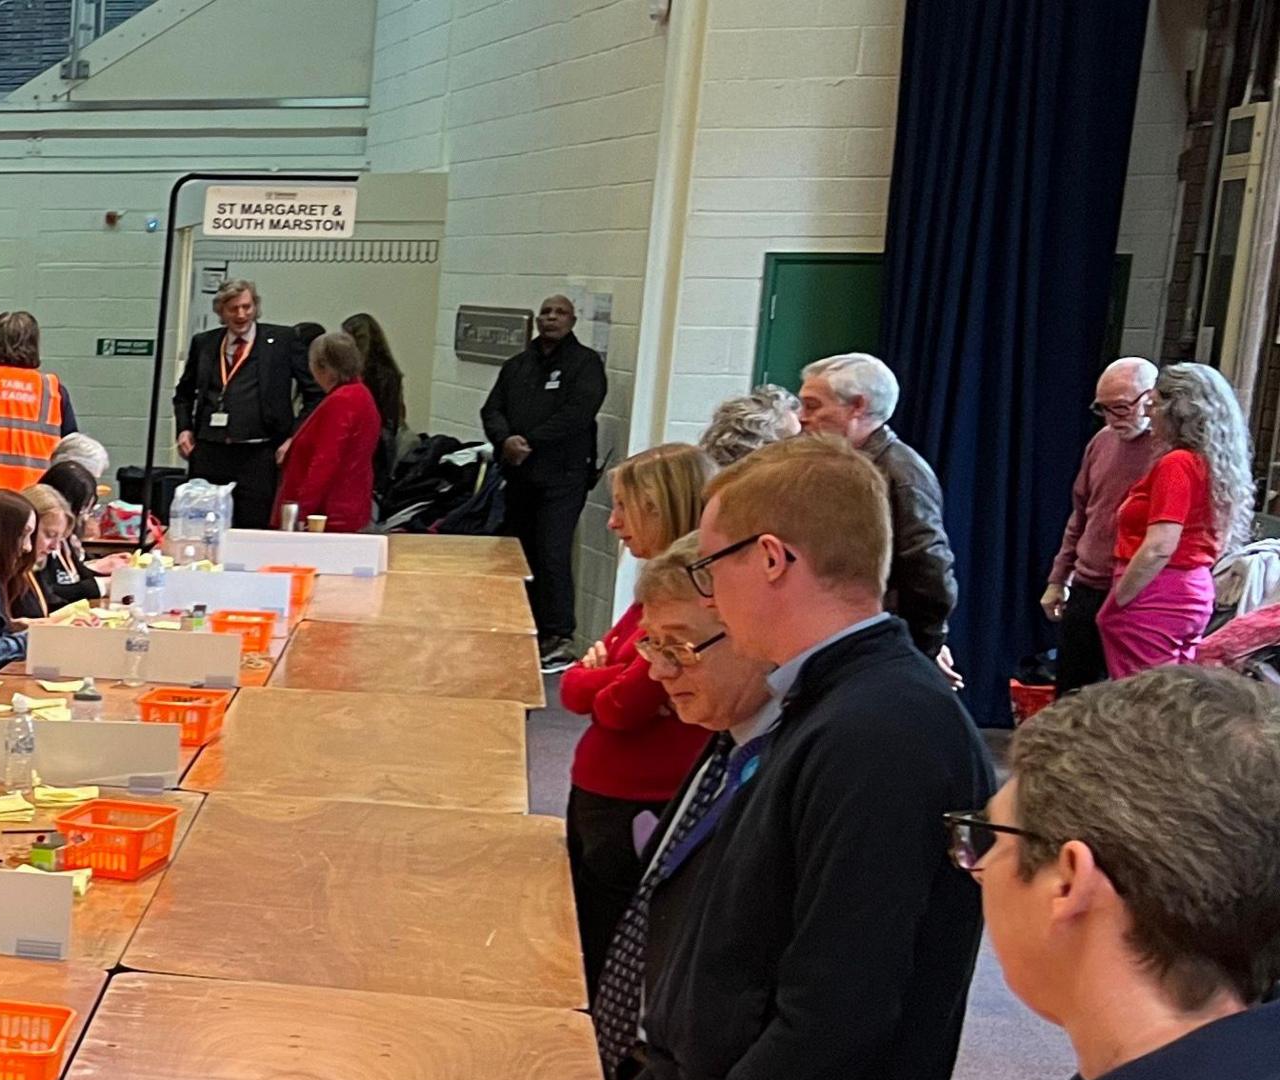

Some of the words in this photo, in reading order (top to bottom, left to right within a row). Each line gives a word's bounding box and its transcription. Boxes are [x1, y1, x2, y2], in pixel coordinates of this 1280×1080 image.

[217, 203, 237, 215] ST
[240, 204, 328, 216] MARGARET
[332, 205, 343, 216] &
[212, 218, 265, 230] SOUTH
[269, 218, 346, 231] MARSTON
[0, 379, 33, 391] TABLE
